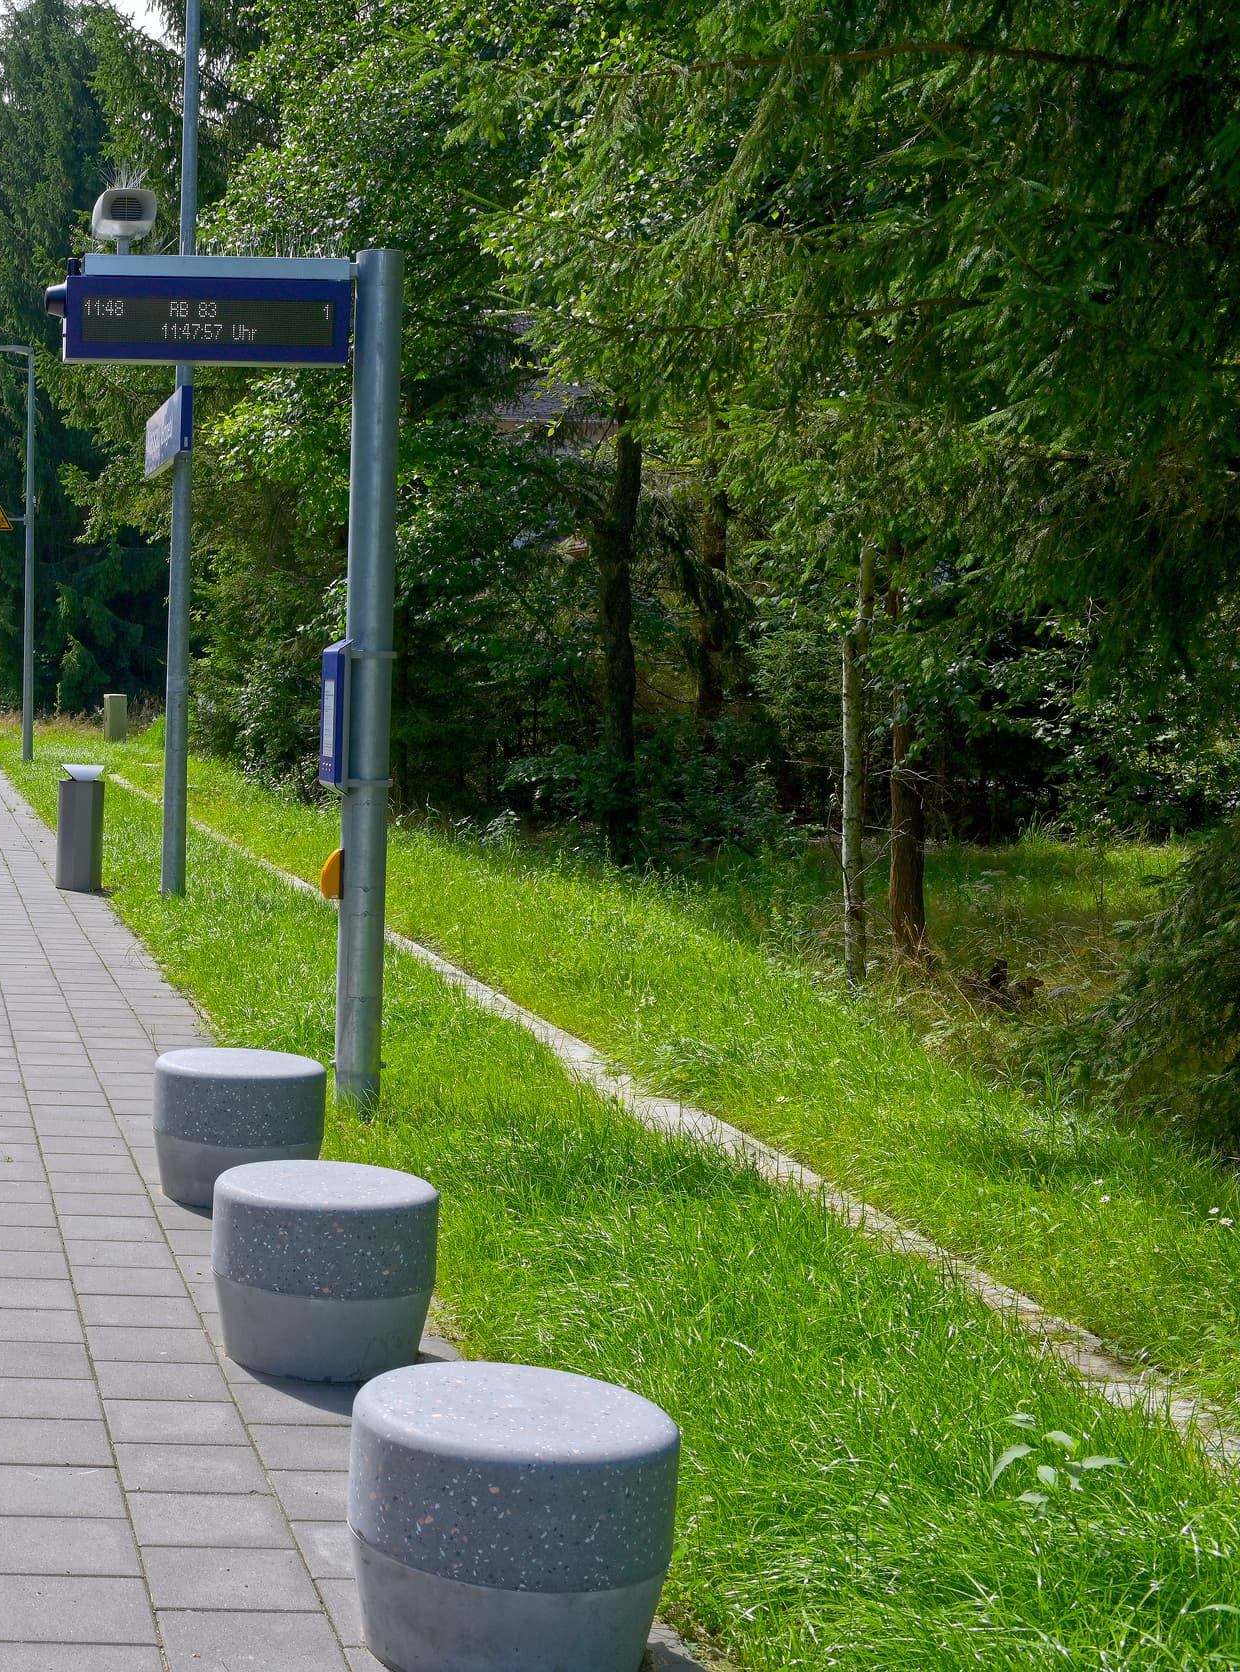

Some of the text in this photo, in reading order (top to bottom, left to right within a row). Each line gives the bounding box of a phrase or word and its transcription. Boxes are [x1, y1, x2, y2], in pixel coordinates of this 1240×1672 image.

[84, 299, 329, 320] 11:48 RB 83 1
[161, 323, 258, 341] 11:47:57 Uhr
